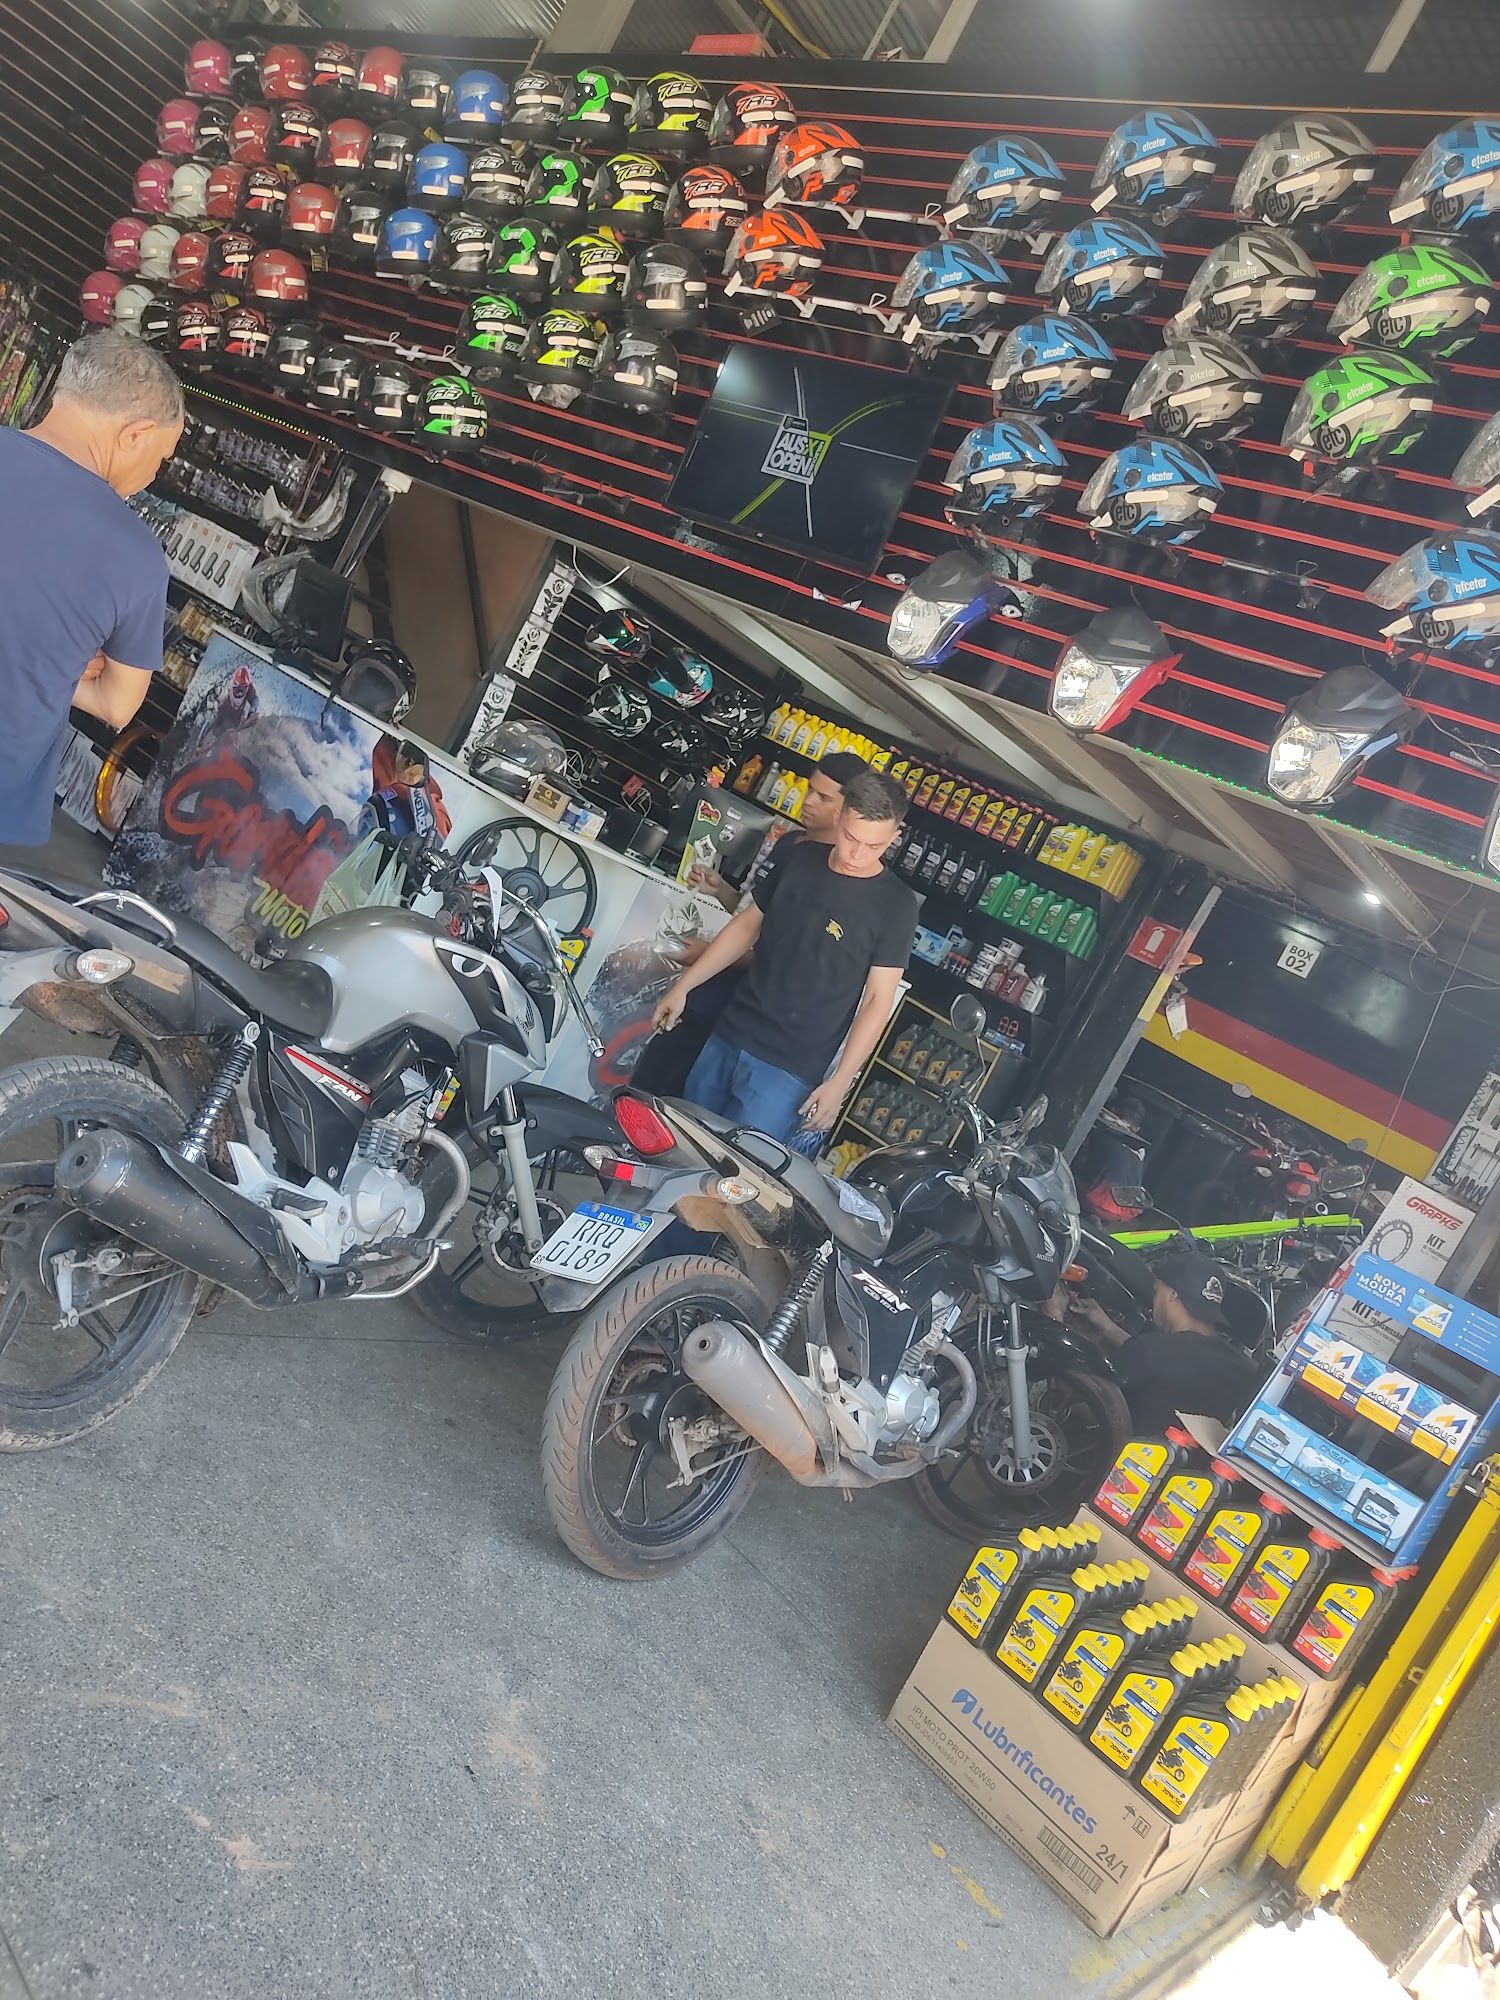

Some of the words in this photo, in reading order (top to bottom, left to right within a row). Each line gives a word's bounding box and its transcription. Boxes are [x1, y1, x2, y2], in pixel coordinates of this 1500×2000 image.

[1320, 425, 1345, 448] etc
[1289, 945, 1315, 961] BOX
[1285, 955, 1306, 973] 02
[515, 1016, 530, 1037] HONDA
[315, 1073, 363, 1102] FAN
[597, 1212, 625, 1226] BRASIL
[571, 1219, 625, 1249] RRQ
[1426, 1234, 1446, 1250] KIT
[851, 1266, 913, 1311] FAN
[1358, 1274, 1403, 1303] MOURA
[1373, 1272, 1407, 1297] NOVA
[1351, 1299, 1375, 1319] KIT
[989, 1573, 1003, 1586] MOTO
[1043, 1615, 1059, 1630] MOTO
[1091, 1657, 1108, 1672] MOTO
[1140, 1700, 1157, 1716] MOTO
[912, 1705, 924, 1719] IPI
[923, 1716, 947, 1741] MOTO
[947, 1739, 969, 1764] PROT
[969, 1762, 997, 1790] 20W50
[1194, 1745, 1212, 1760] MOTO
[972, 1706, 1098, 1835] Lubrificantes
[1095, 1844, 1129, 1879] 24/1
